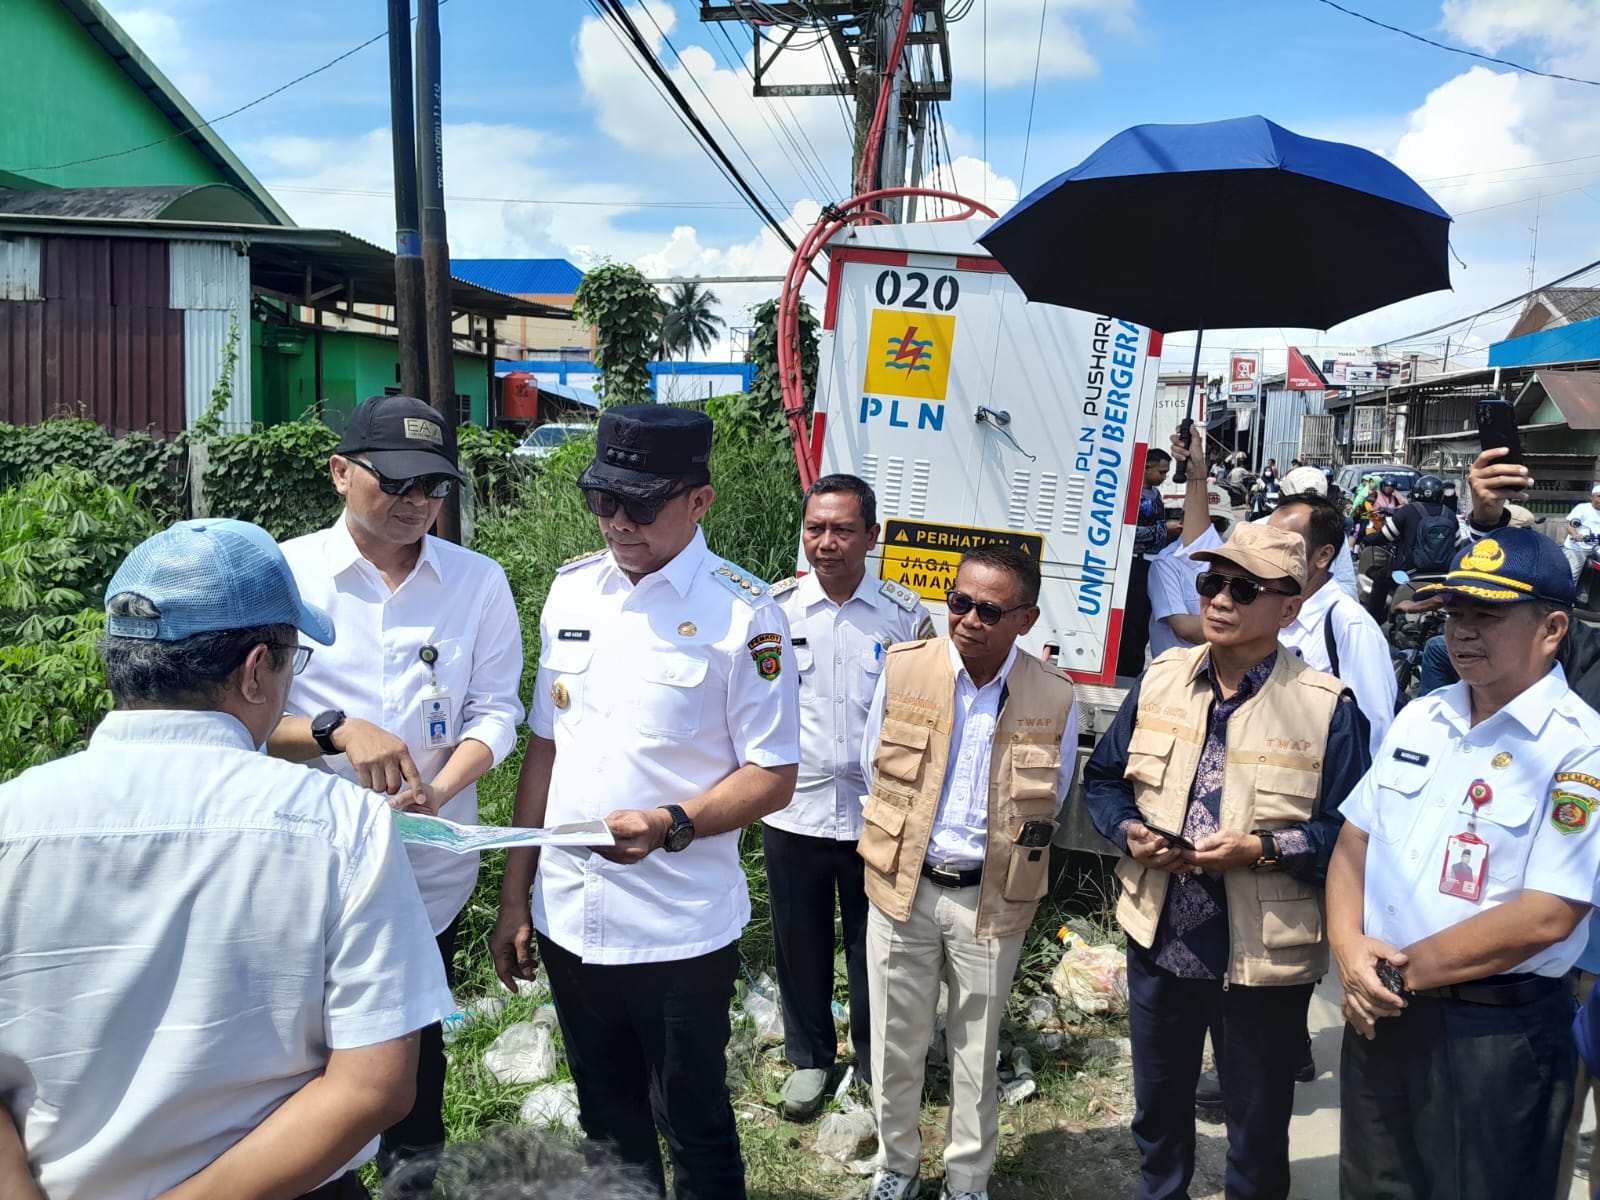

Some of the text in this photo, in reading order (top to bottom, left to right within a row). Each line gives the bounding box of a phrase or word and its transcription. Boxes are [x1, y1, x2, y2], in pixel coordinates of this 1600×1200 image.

[875, 270, 960, 311] 020
[860, 397, 945, 431] PLN
[1075, 427, 1097, 472] PLN
[1087, 447, 1122, 547] GARDU
[900, 572, 957, 590] AMAN
[901, 556, 950, 573] JAGA
[1078, 549, 1107, 616] UNIT
[1016, 718, 1052, 727] TWAP
[1266, 738, 1312, 751] TWAP
